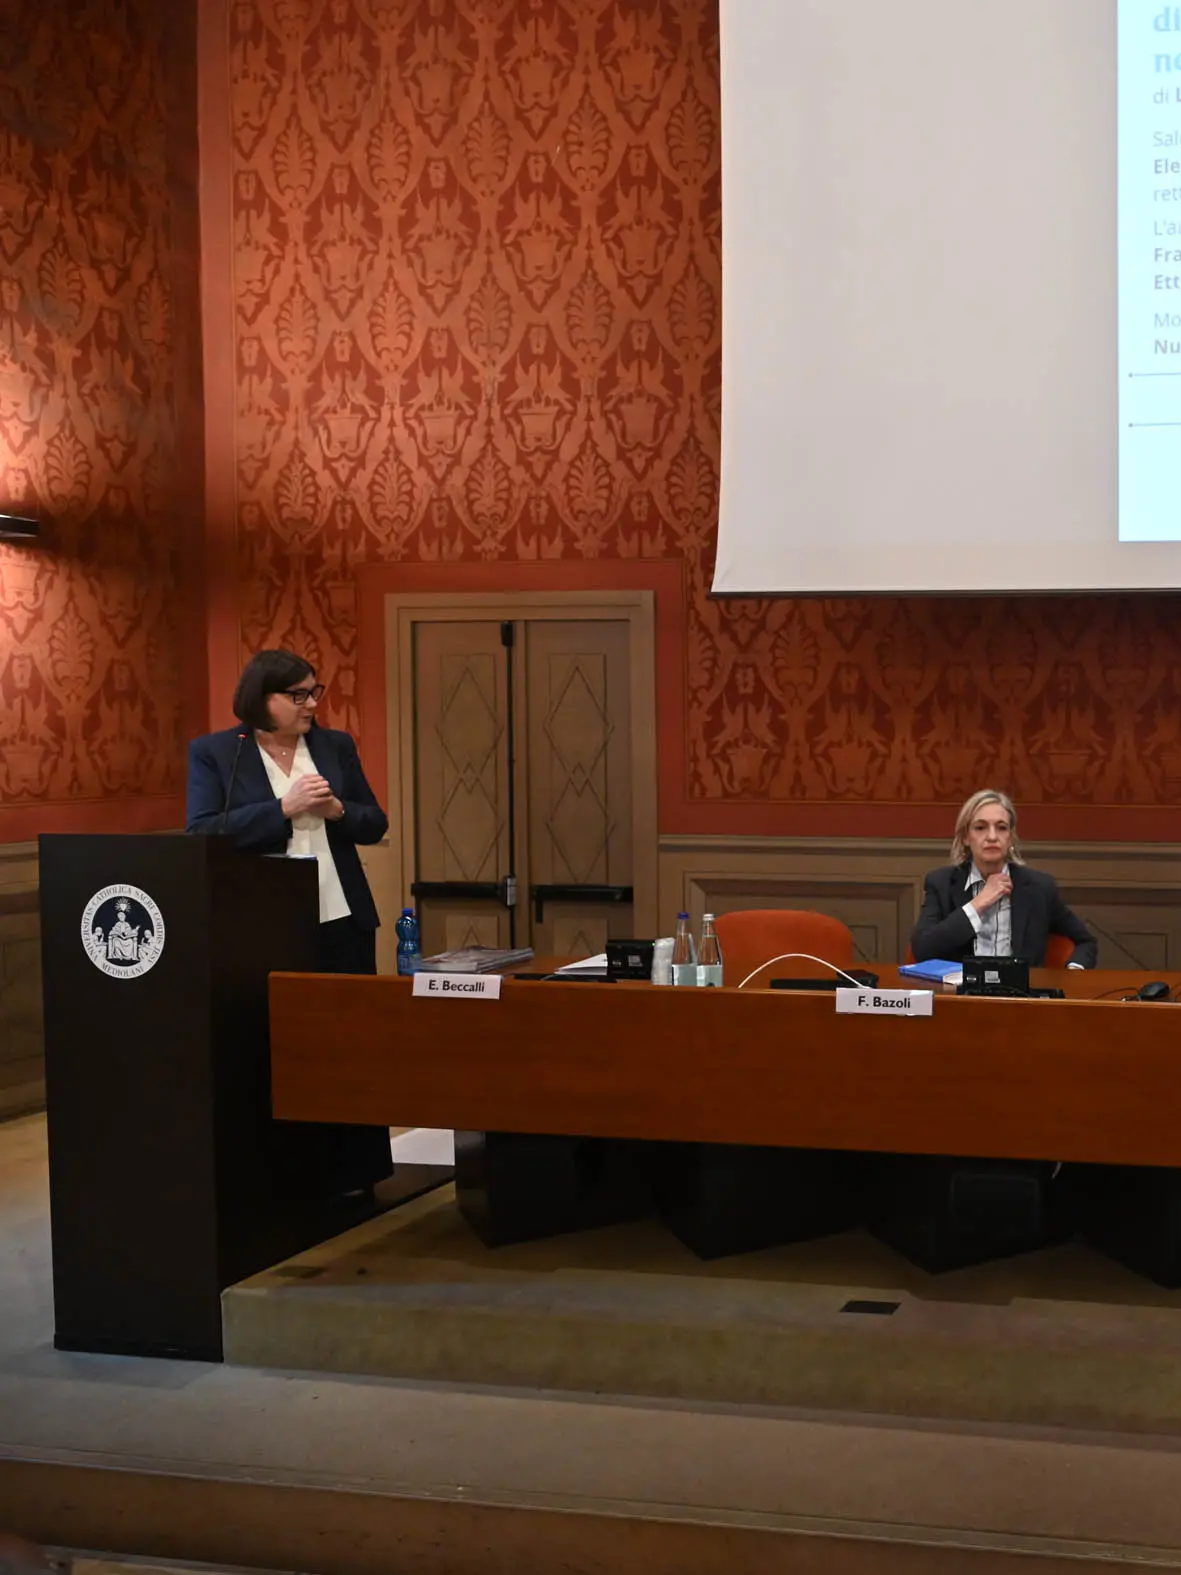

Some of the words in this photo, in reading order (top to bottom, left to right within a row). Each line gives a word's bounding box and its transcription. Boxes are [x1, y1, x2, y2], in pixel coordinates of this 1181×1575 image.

[1153, 6, 1181, 32] di
[1153, 87, 1169, 104] di
[428, 979, 439, 991] E.
[442, 980, 485, 992] Beccalli
[858, 995, 869, 1007] F.
[873, 996, 911, 1008] Bazoli
